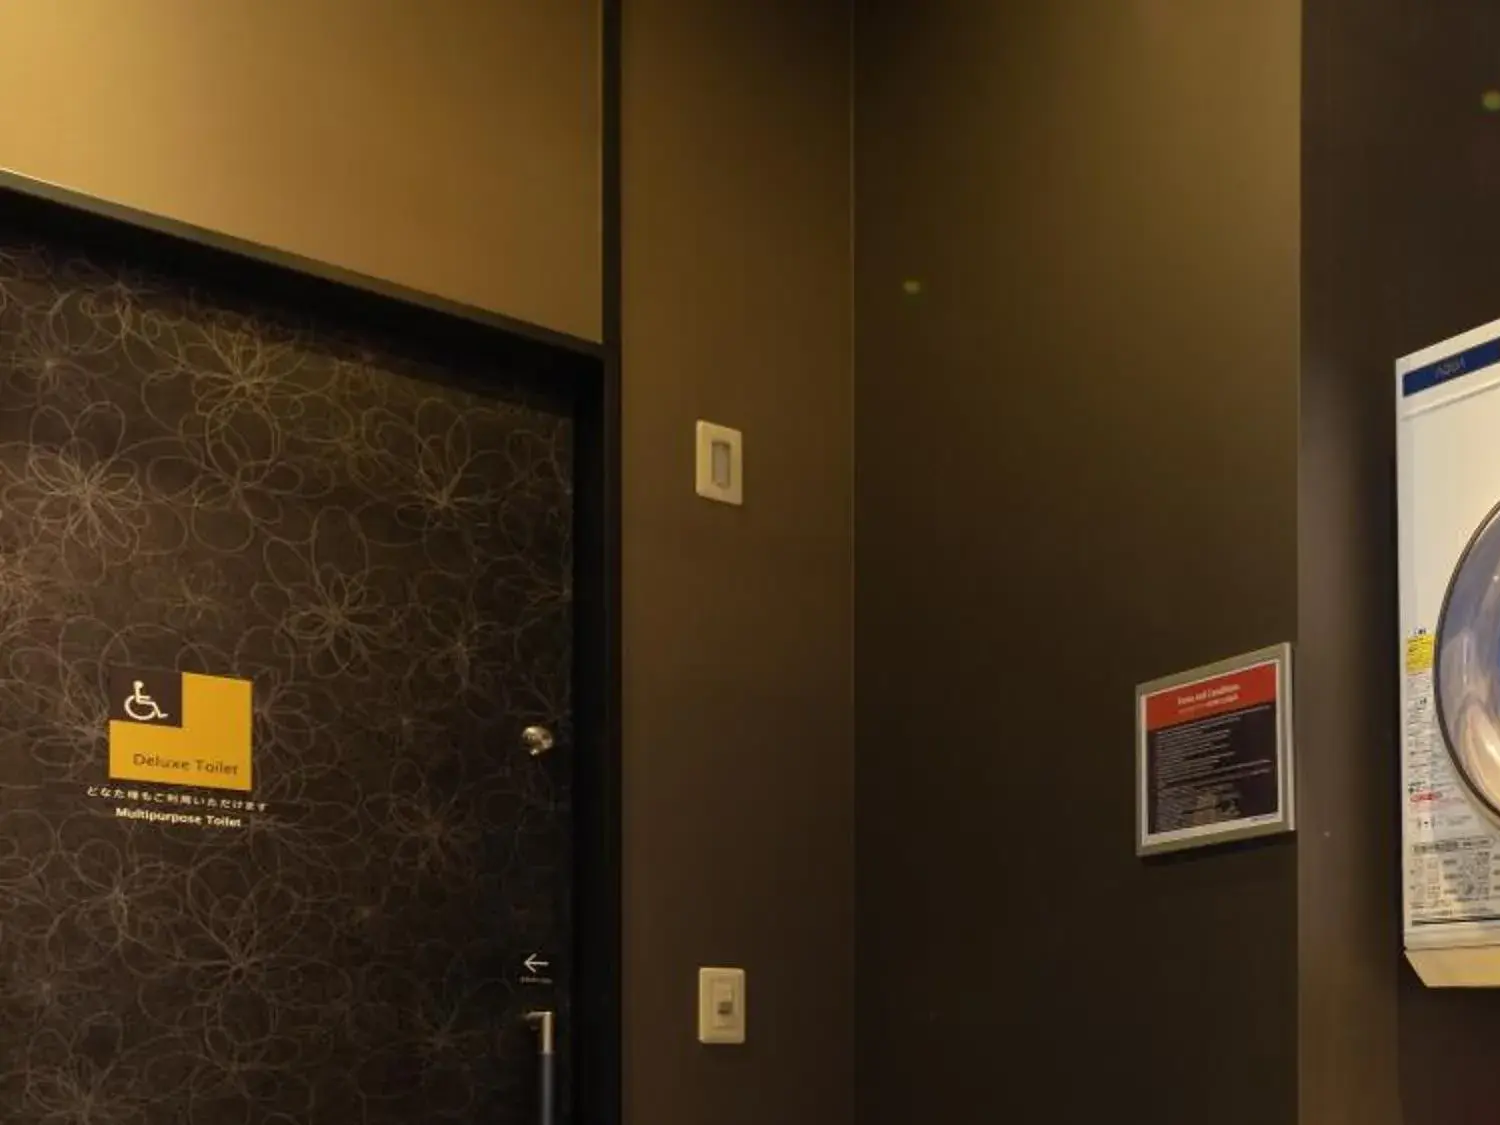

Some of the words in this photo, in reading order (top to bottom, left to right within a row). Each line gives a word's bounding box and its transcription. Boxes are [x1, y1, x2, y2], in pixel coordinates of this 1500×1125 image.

[133, 753, 190, 771] Deluxe
[196, 759, 239, 776] Toilet
[115, 807, 201, 826] Multipurpose
[206, 815, 242, 828] Toilet
